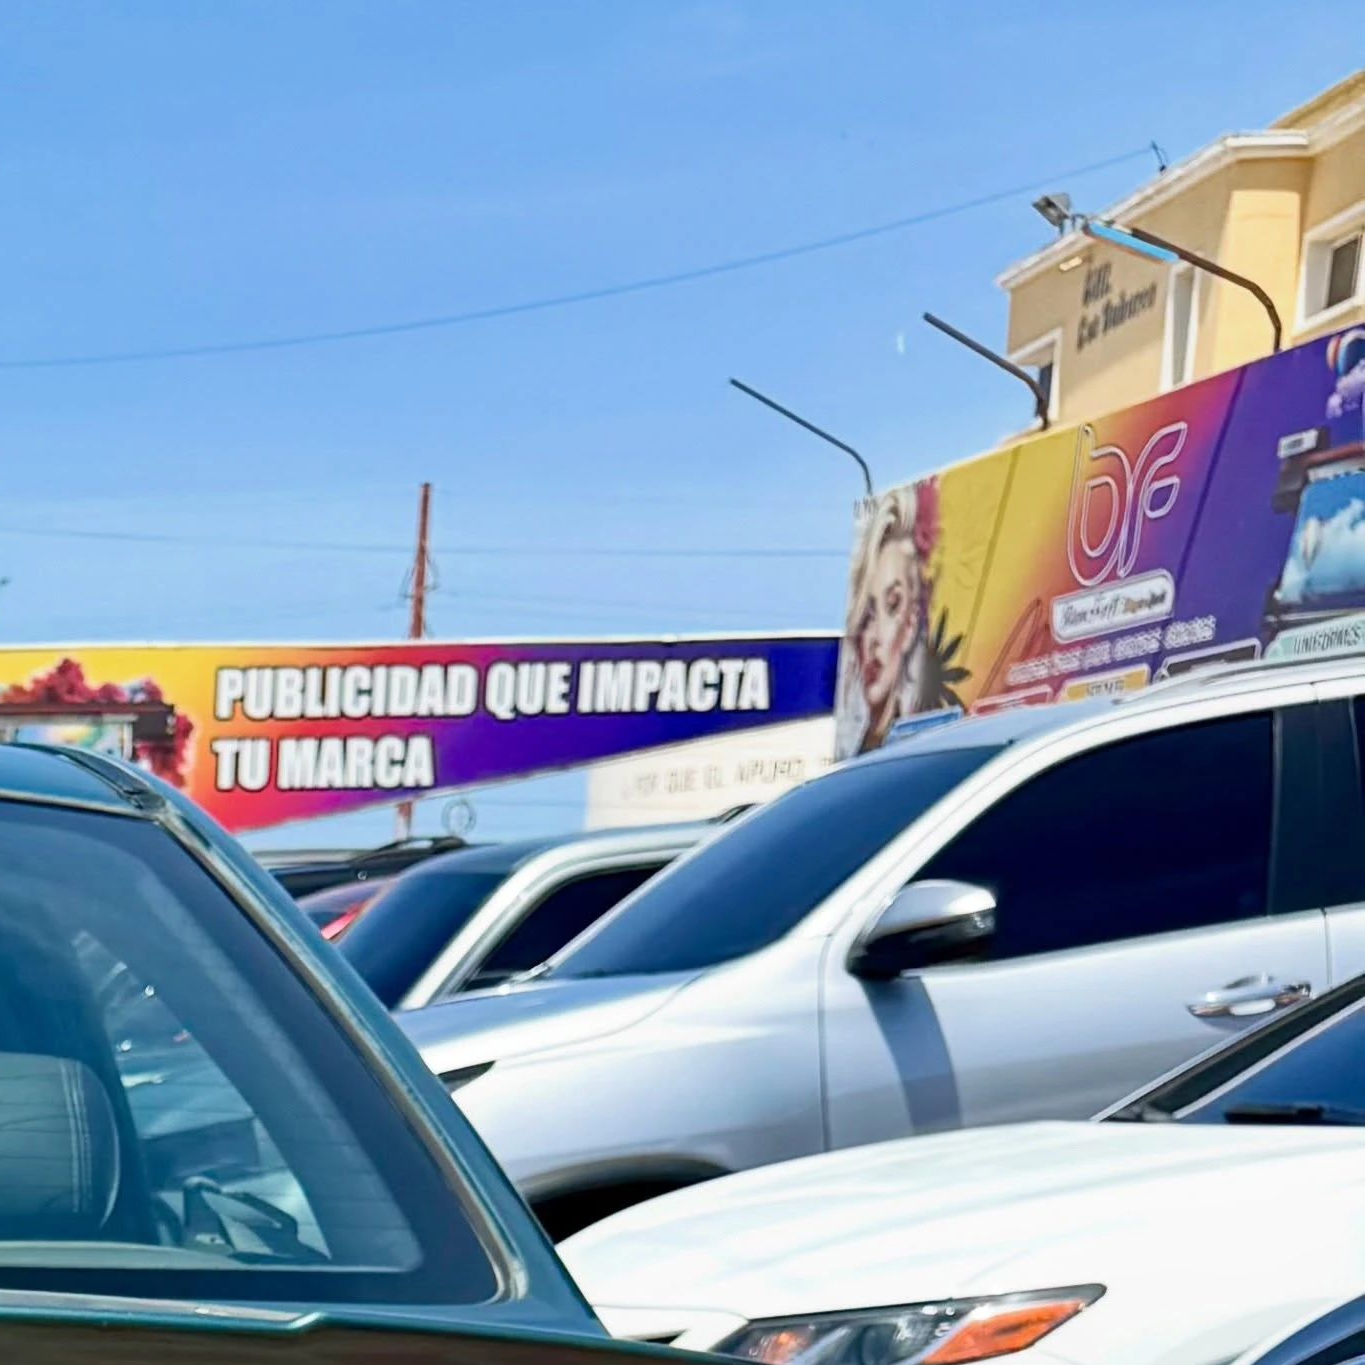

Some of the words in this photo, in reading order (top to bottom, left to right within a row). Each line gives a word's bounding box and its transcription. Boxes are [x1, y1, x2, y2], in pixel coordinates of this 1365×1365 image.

[214, 664, 479, 720] PUBLICIDAD
[484, 661, 570, 721] QUE
[576, 658, 770, 714] IMPACTA
[211, 738, 270, 790] TU
[276, 735, 436, 790] MARCA
